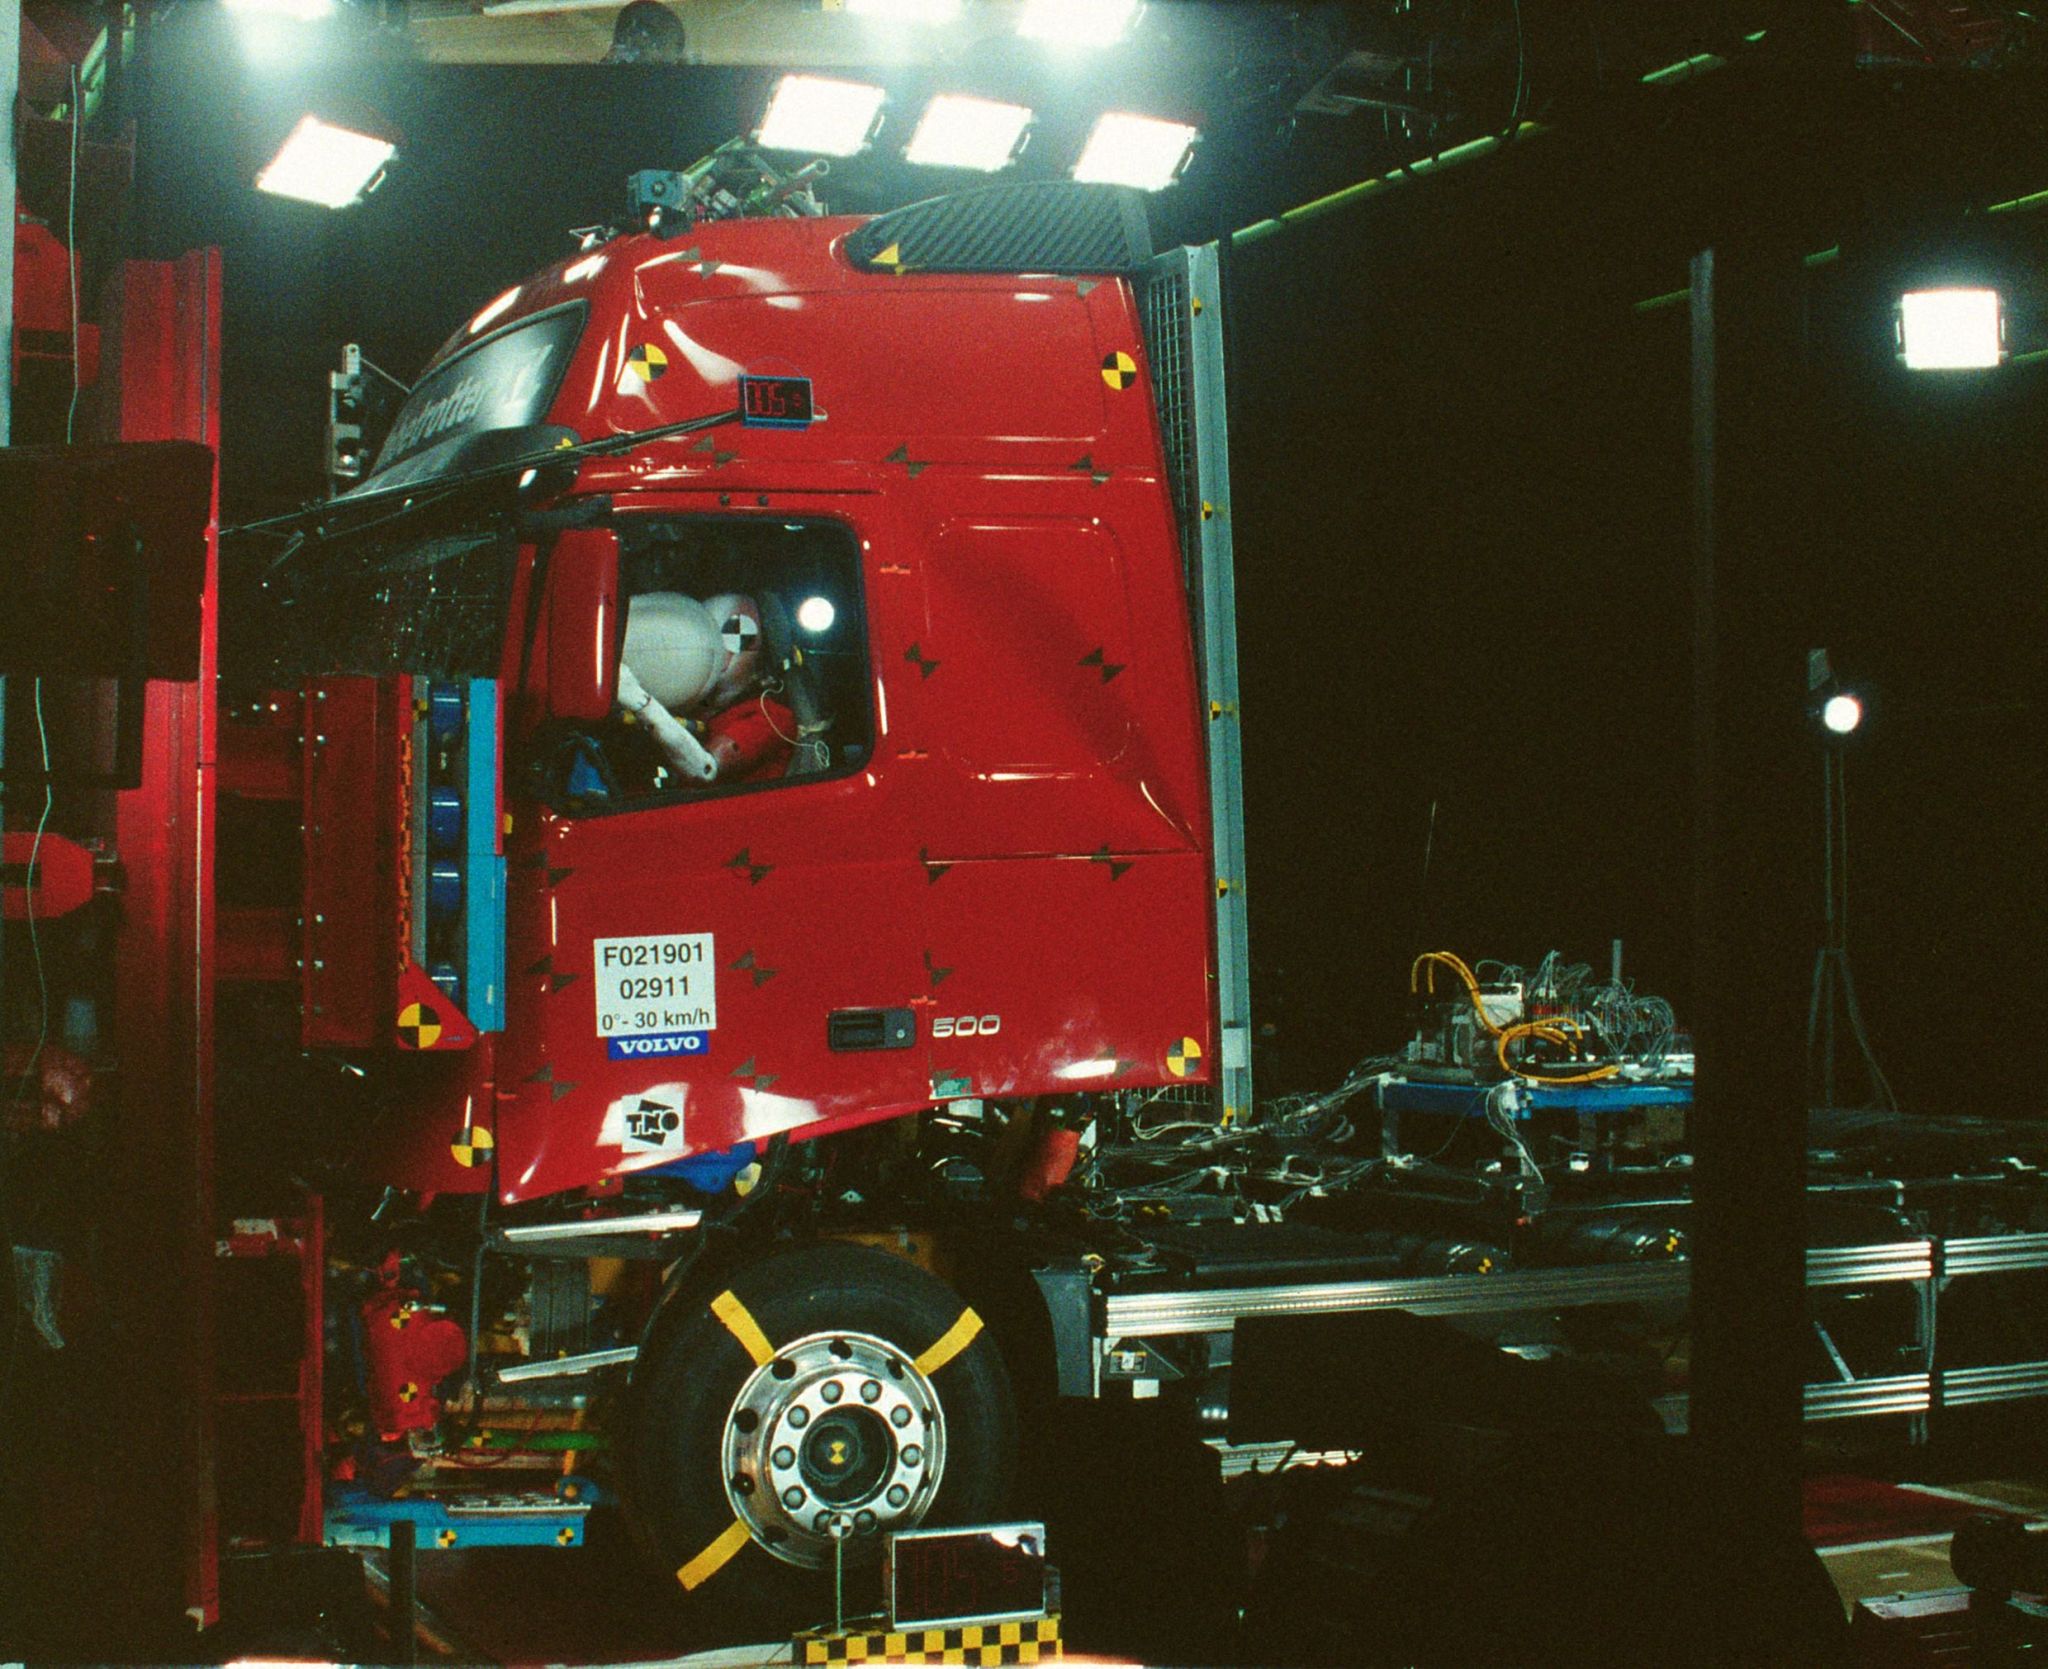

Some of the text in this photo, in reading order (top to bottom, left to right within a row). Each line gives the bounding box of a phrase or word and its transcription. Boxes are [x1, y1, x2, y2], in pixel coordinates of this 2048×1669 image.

[603, 941, 704, 967] F021901
[619, 975, 690, 1000] 02911
[634, 1011, 658, 1029] 30
[663, 1007, 711, 1027] km/h
[932, 1014, 1001, 1038] 500
[616, 1035, 700, 1055] VOLVO
[625, 1111, 680, 1133] TNO
